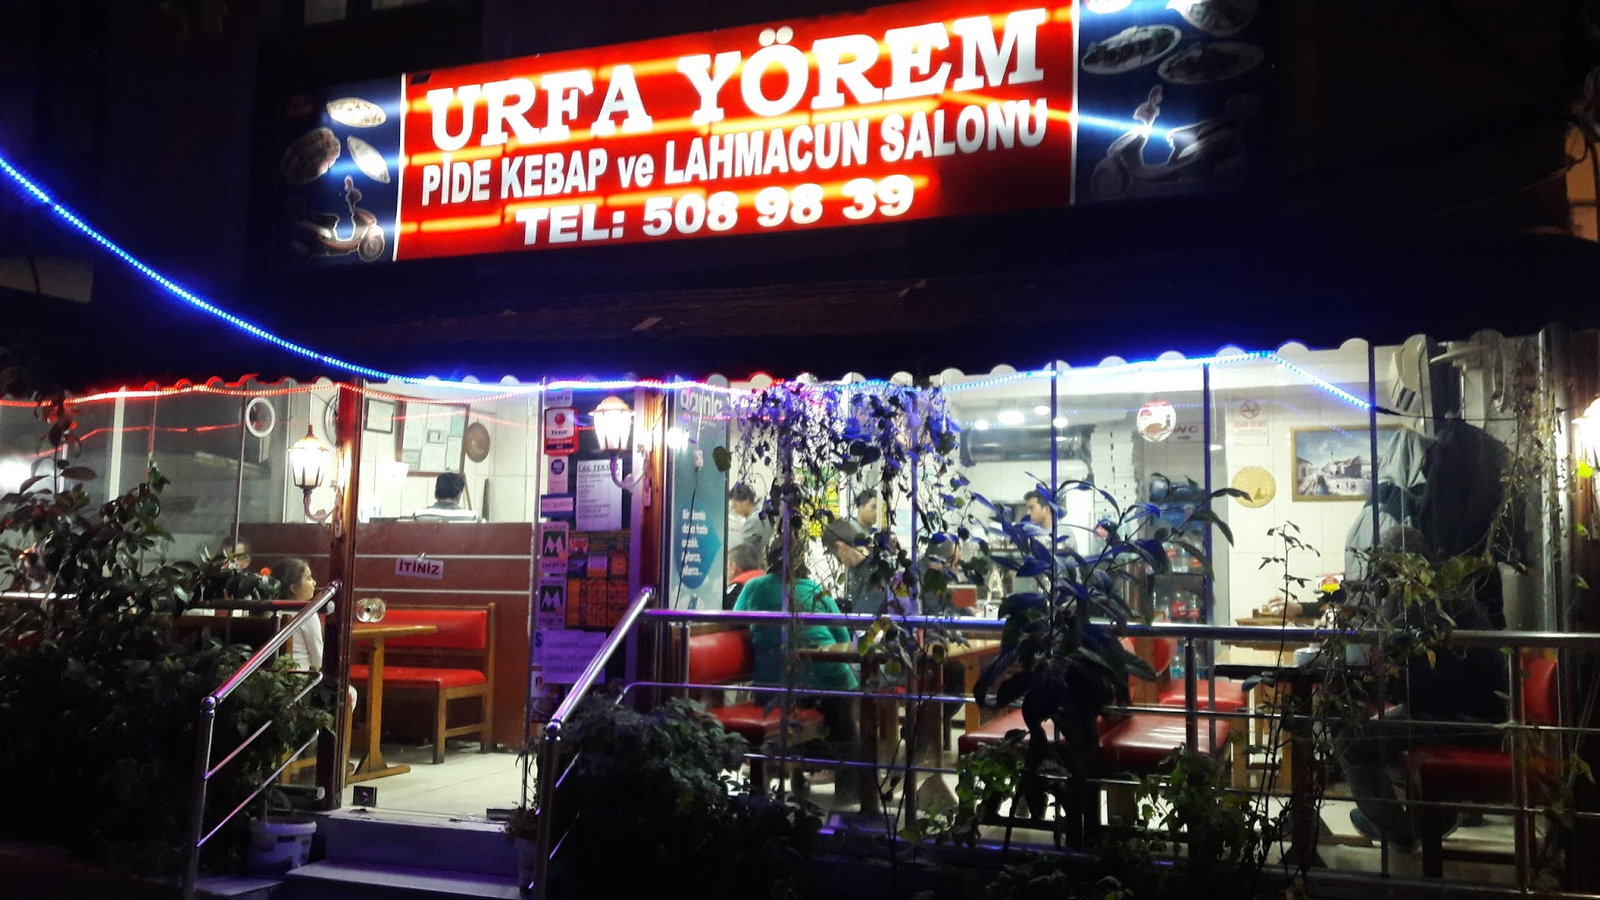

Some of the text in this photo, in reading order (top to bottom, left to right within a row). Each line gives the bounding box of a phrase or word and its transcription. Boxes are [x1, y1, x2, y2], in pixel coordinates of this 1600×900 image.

[426, 8, 1047, 151] URFA YÖREM
[422, 98, 1048, 205] PİDE KEBAP ve LAHMACUN SALONU
[517, 174, 914, 247] TEL: 508 98 39
